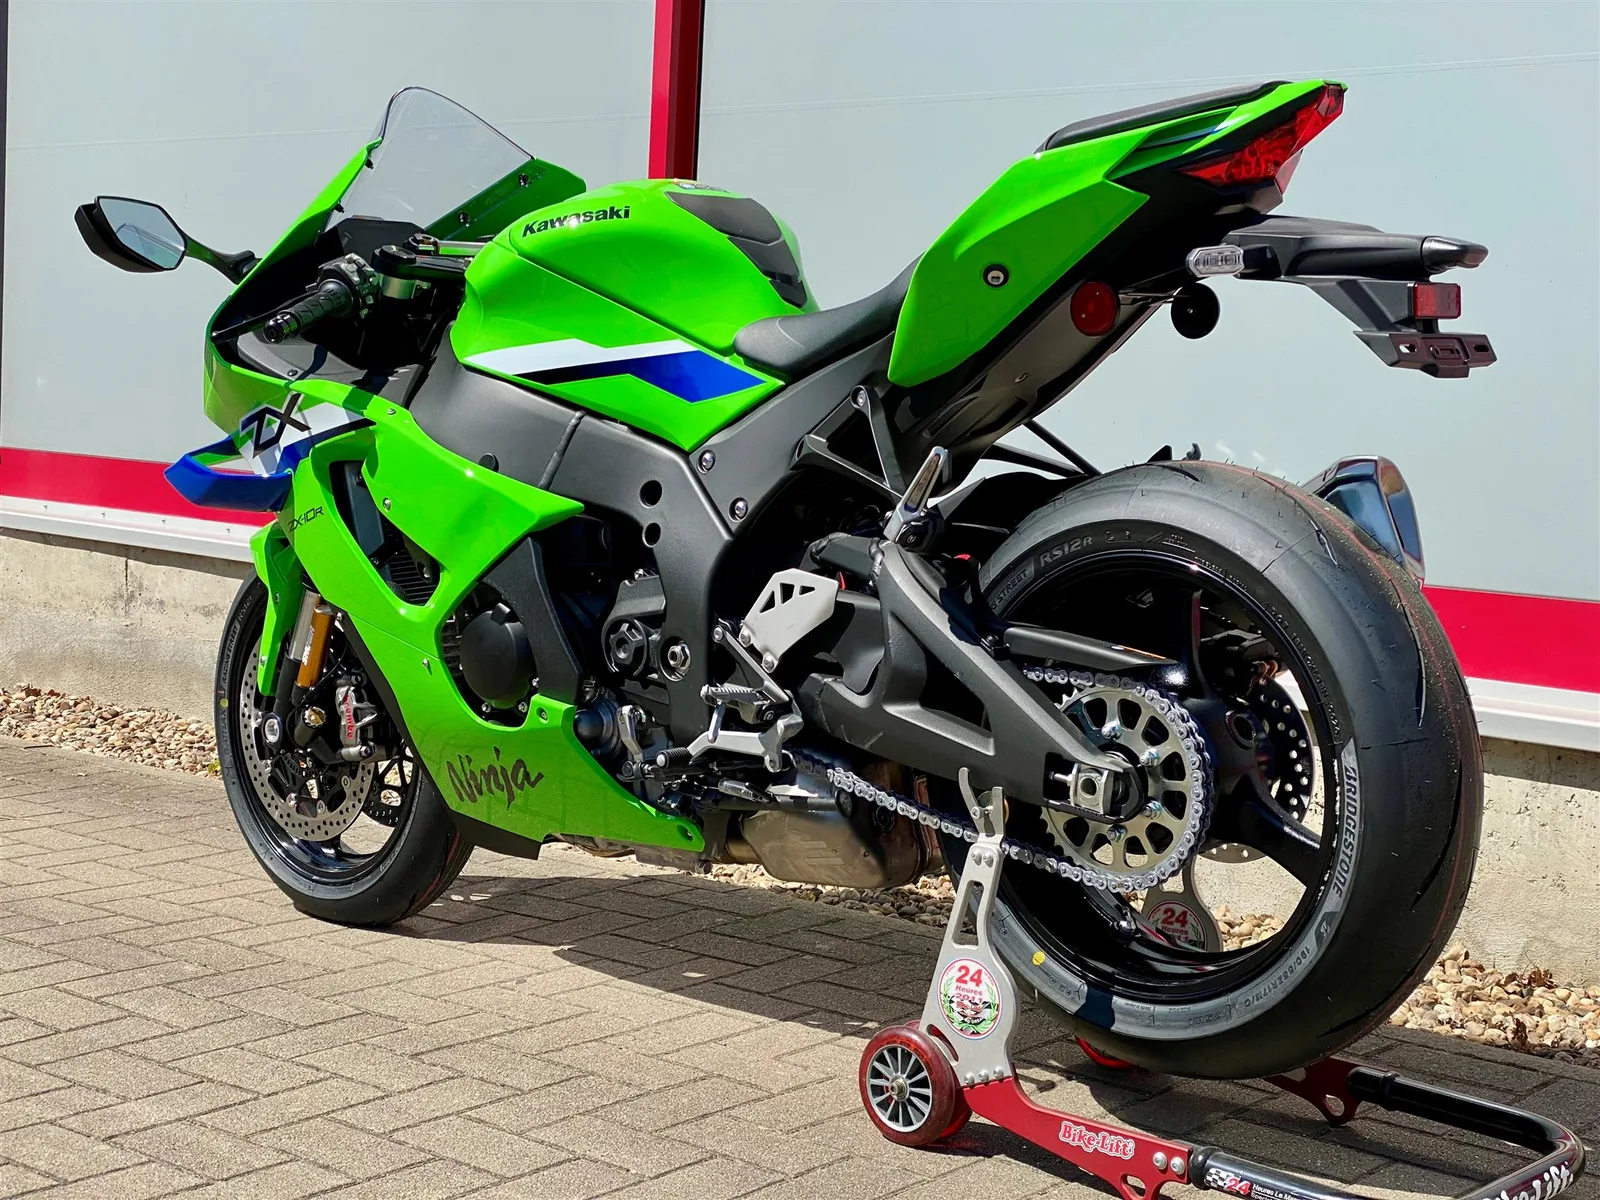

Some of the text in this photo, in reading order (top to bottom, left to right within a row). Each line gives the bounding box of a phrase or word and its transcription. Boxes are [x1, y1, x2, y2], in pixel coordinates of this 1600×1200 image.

[522, 206, 631, 238] Kawasaki
[240, 392, 312, 459] ZX
[997, 568, 1027, 604] STREET
[446, 745, 544, 811] Ninja
[1332, 765, 1358, 898] BRIDGESTONE
[1161, 907, 1188, 928] 24
[1161, 925, 1189, 936] Heures
[955, 965, 983, 987] 24
[955, 984, 984, 997] Heures
[955, 993, 984, 1004] 2011
[1225, 1177, 1251, 1195] 24
[1252, 1183, 1274, 1196] Heures
